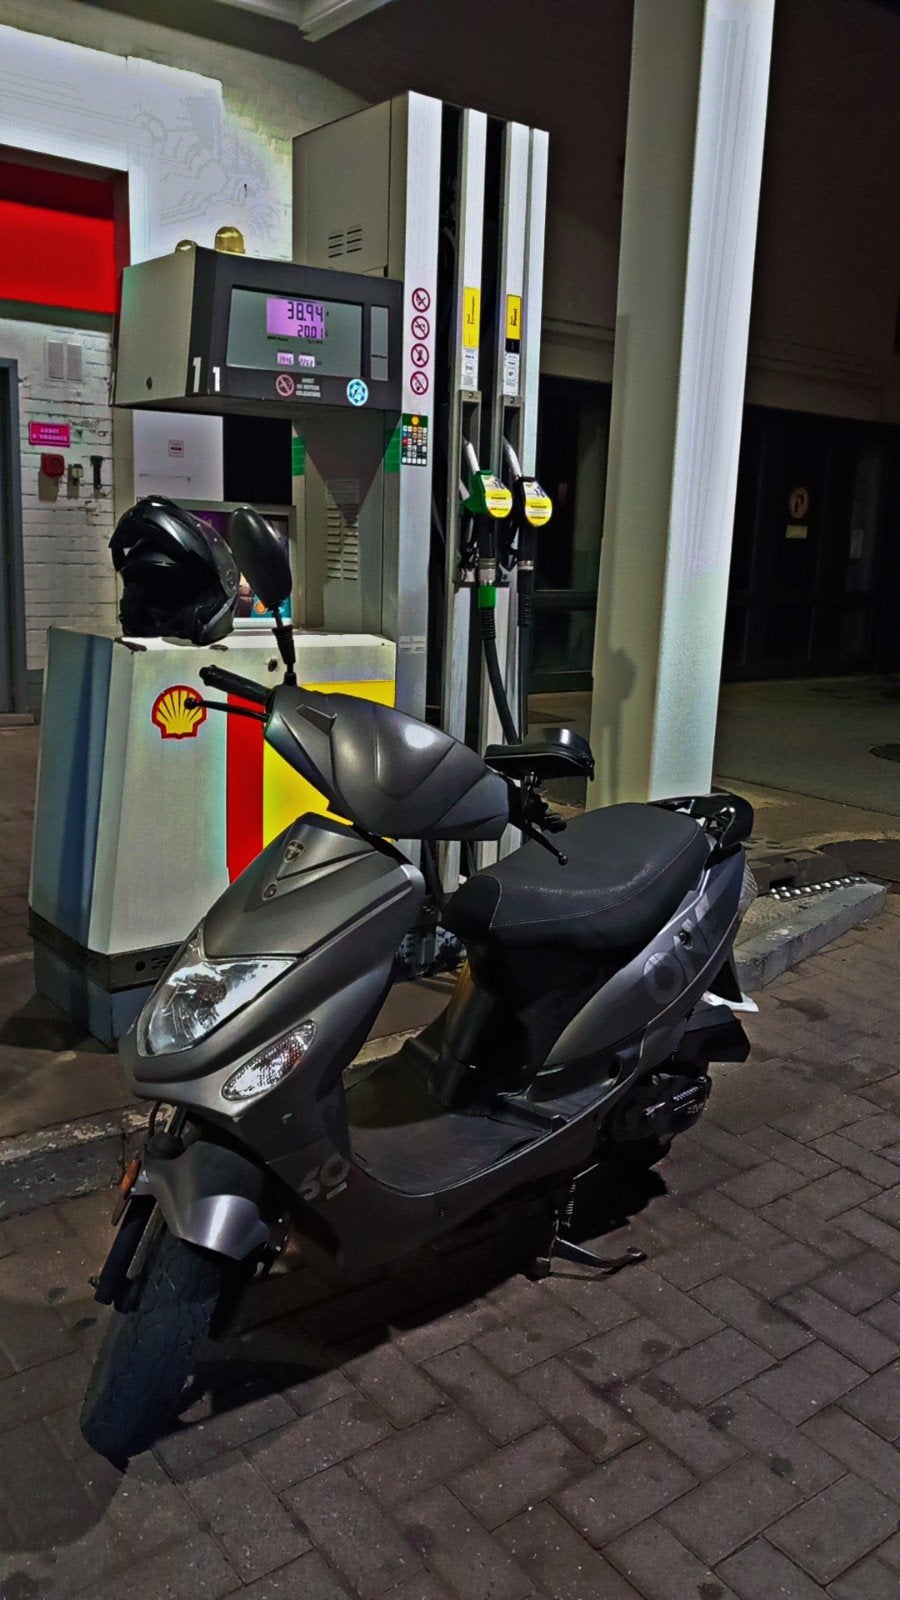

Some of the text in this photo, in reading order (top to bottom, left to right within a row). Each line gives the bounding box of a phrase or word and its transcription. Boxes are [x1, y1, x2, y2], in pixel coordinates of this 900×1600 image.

[287, 301, 323, 322] 38.94
[192, 356, 201, 393] 1
[212, 366, 221, 392] 1
